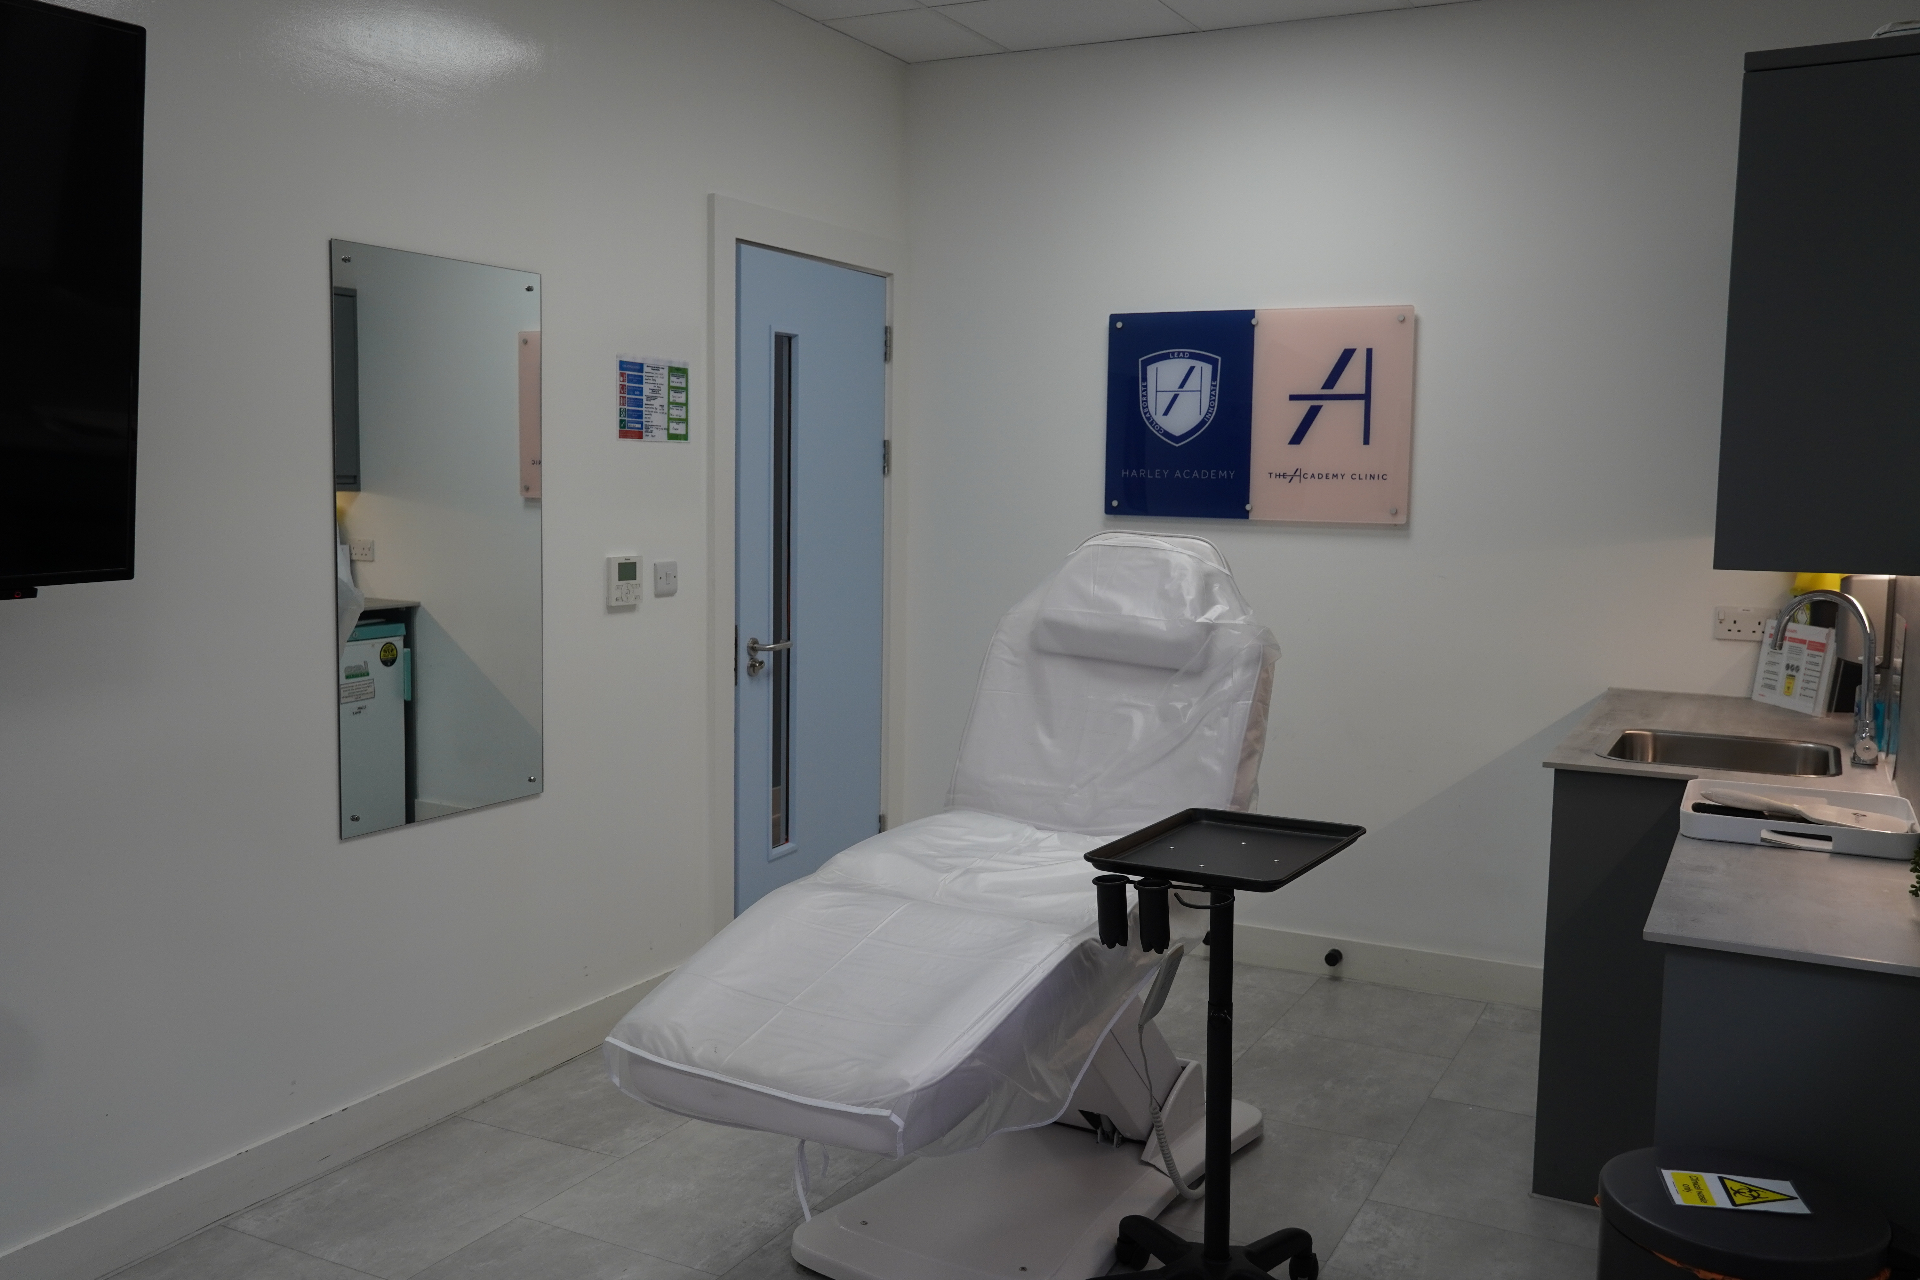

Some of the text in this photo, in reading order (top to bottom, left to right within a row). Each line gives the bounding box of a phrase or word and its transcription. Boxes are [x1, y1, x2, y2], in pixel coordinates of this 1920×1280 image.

[1141, 380, 1165, 435] COLLABORATE
[1204, 379, 1218, 423] INNOVATE
[1121, 468, 1236, 480] HARLEY ACADEMY
[1350, 473, 1388, 481] CLINIC
